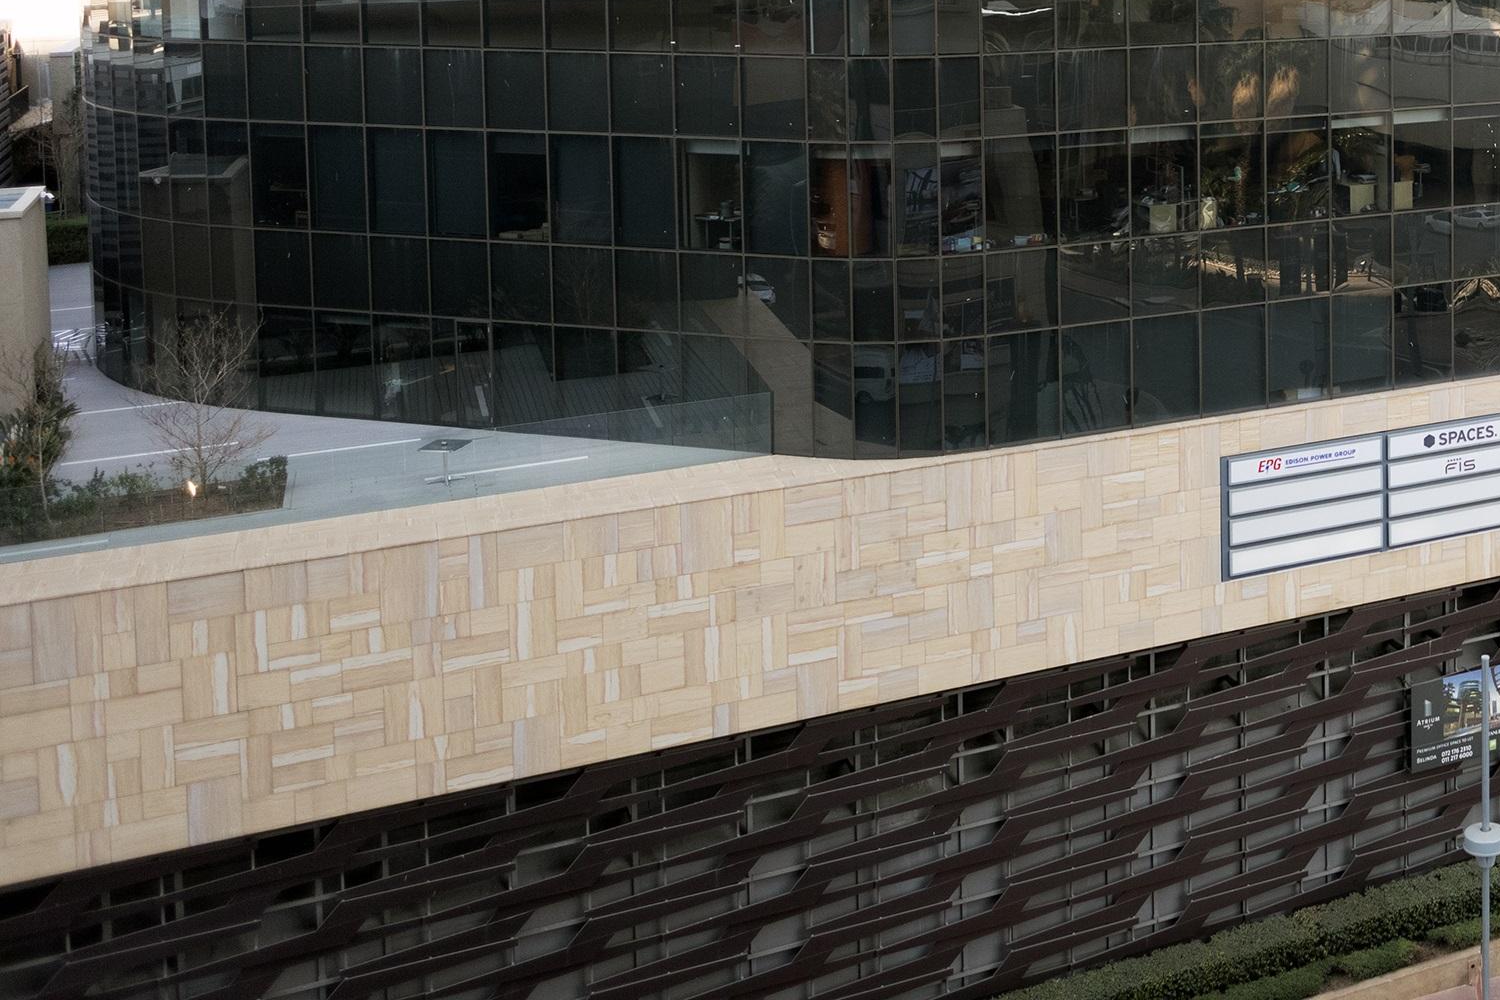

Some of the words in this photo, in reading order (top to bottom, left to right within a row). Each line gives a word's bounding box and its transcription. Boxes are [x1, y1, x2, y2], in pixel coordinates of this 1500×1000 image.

[1439, 425, 1497, 445] SPACES.
[1257, 457, 1282, 473] EPG
[1285, 456, 1309, 466] EDISON
[1310, 453, 1332, 461] POWER
[1334, 449, 1356, 458] GROUP
[1445, 457, 1476, 475] FIS
[1416, 716, 1440, 727] ATRIUM
[1416, 754, 1437, 764] BELINDA
